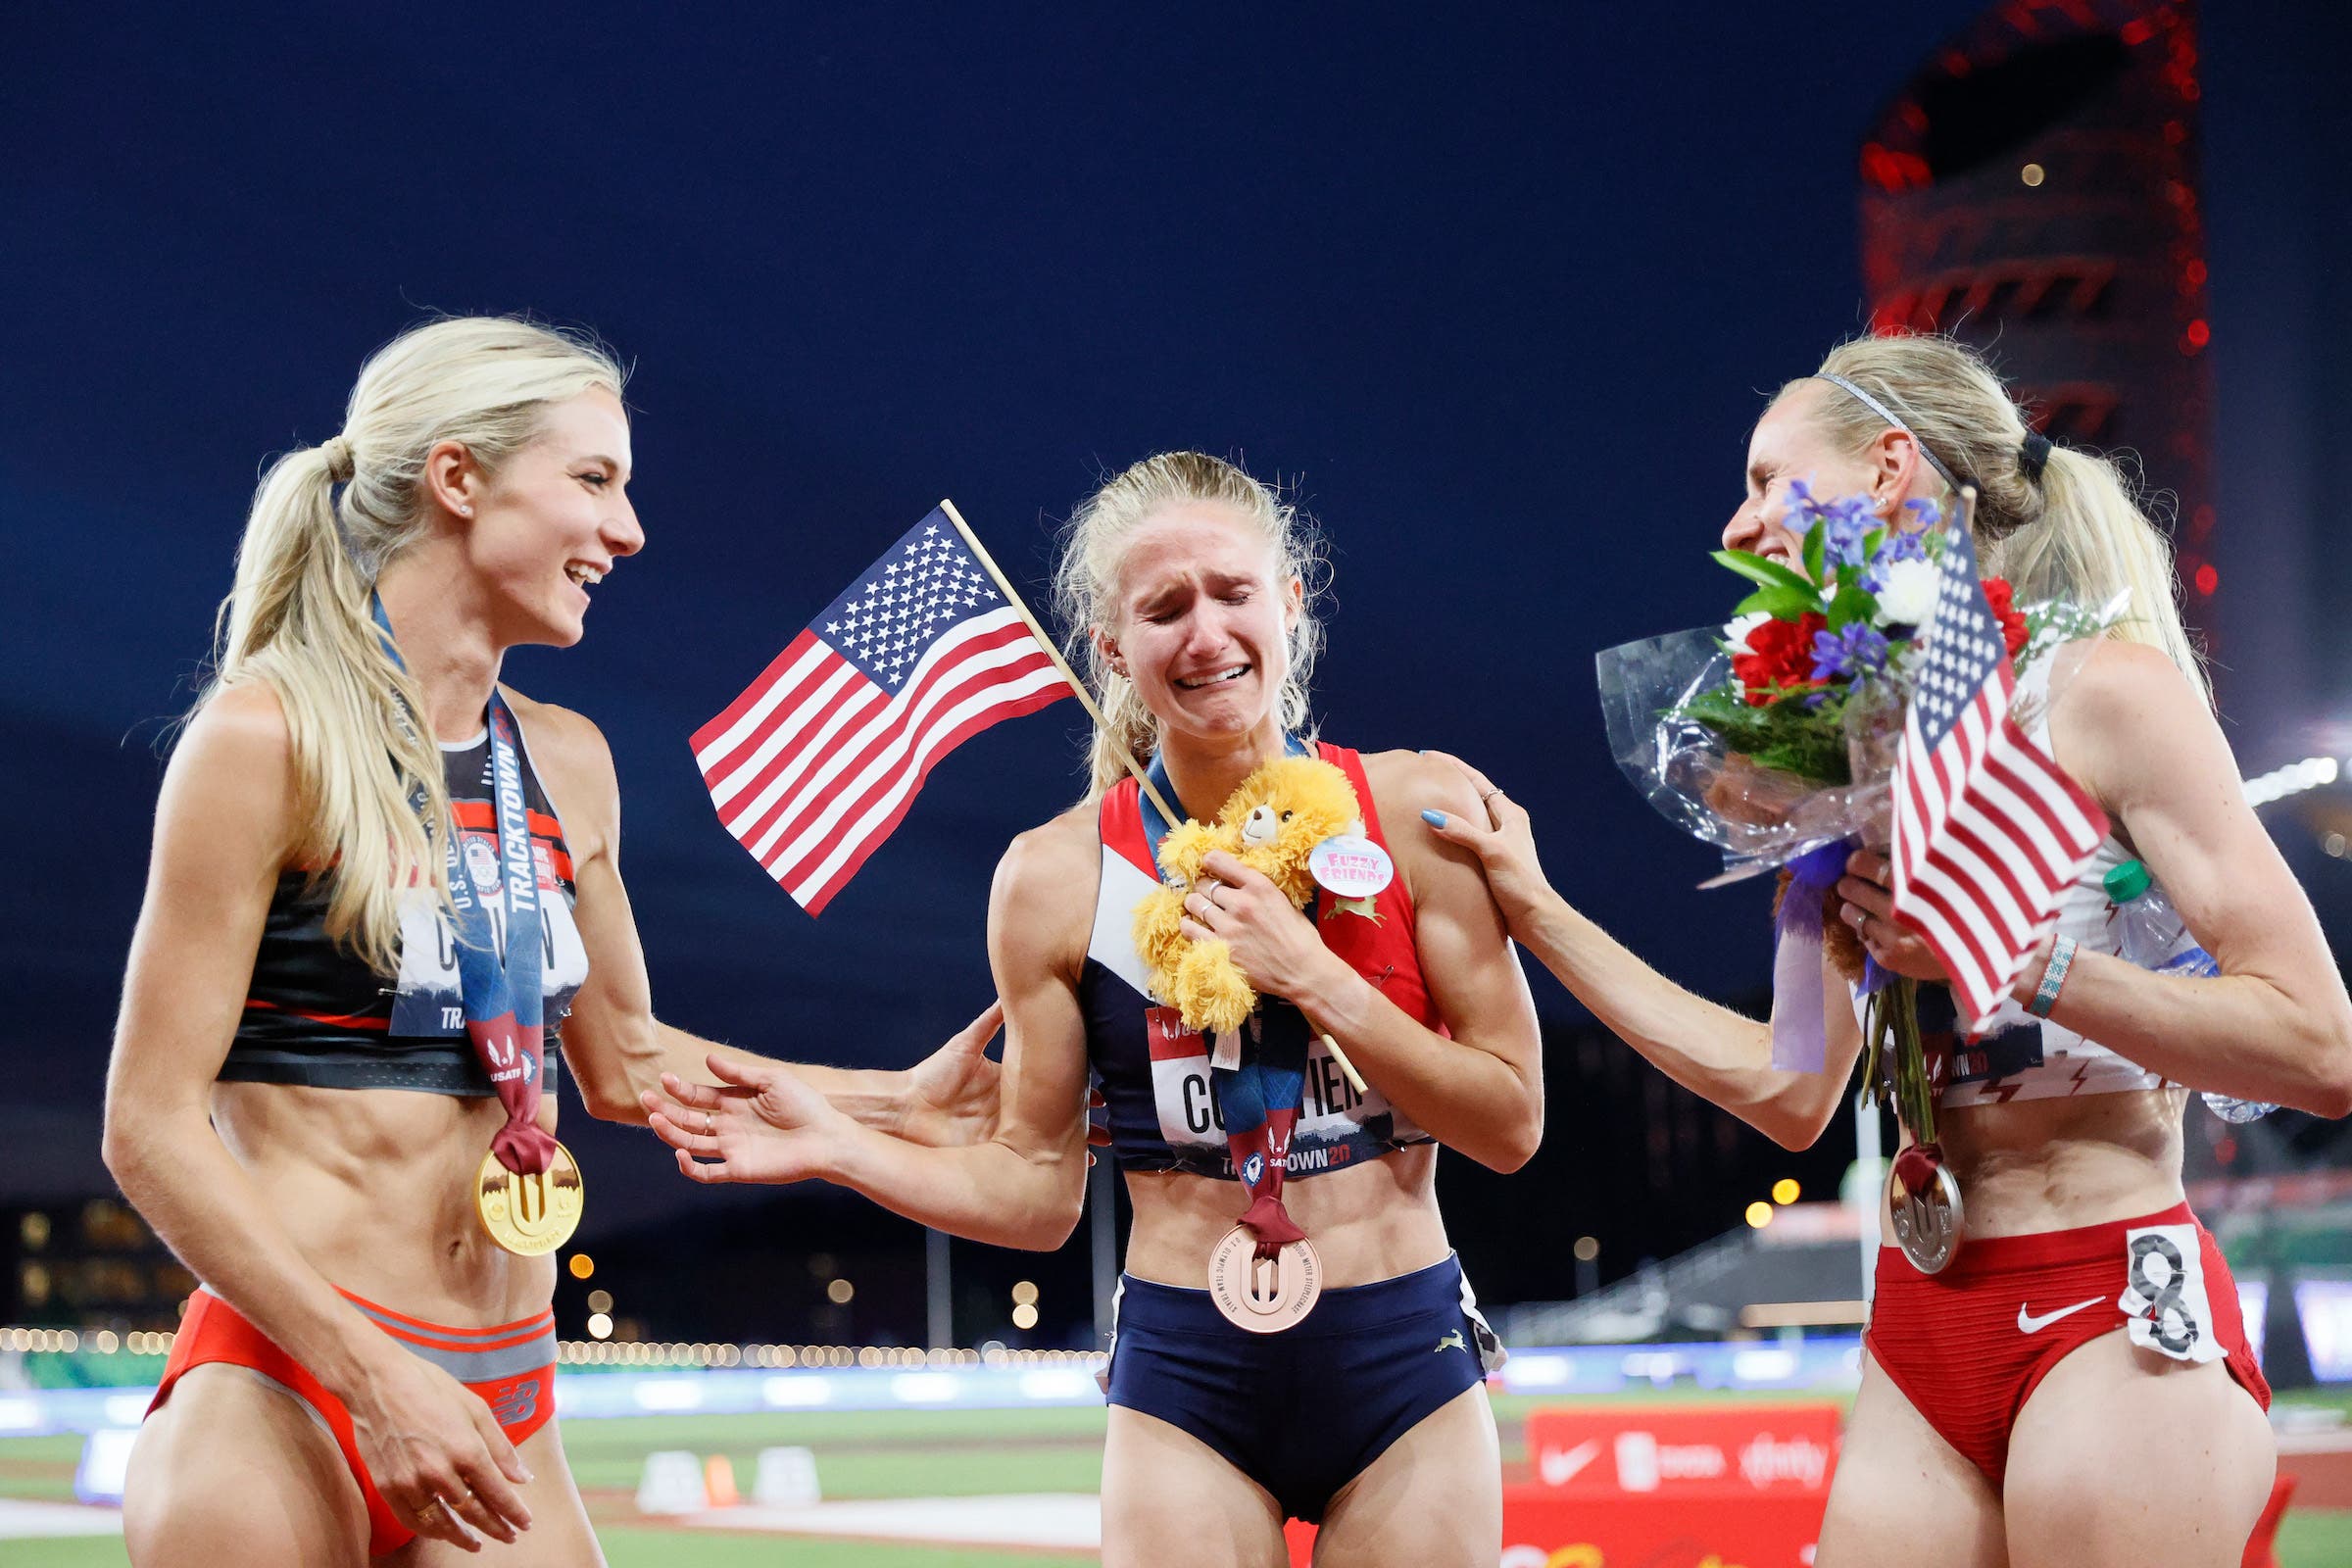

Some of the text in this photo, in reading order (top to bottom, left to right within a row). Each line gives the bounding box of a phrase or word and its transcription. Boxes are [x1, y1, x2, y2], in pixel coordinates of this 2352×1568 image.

[1326, 852, 1380, 870] FUZZY
[1319, 866, 1385, 885] FRIENDS
[2131, 1233, 2199, 1353] 8
